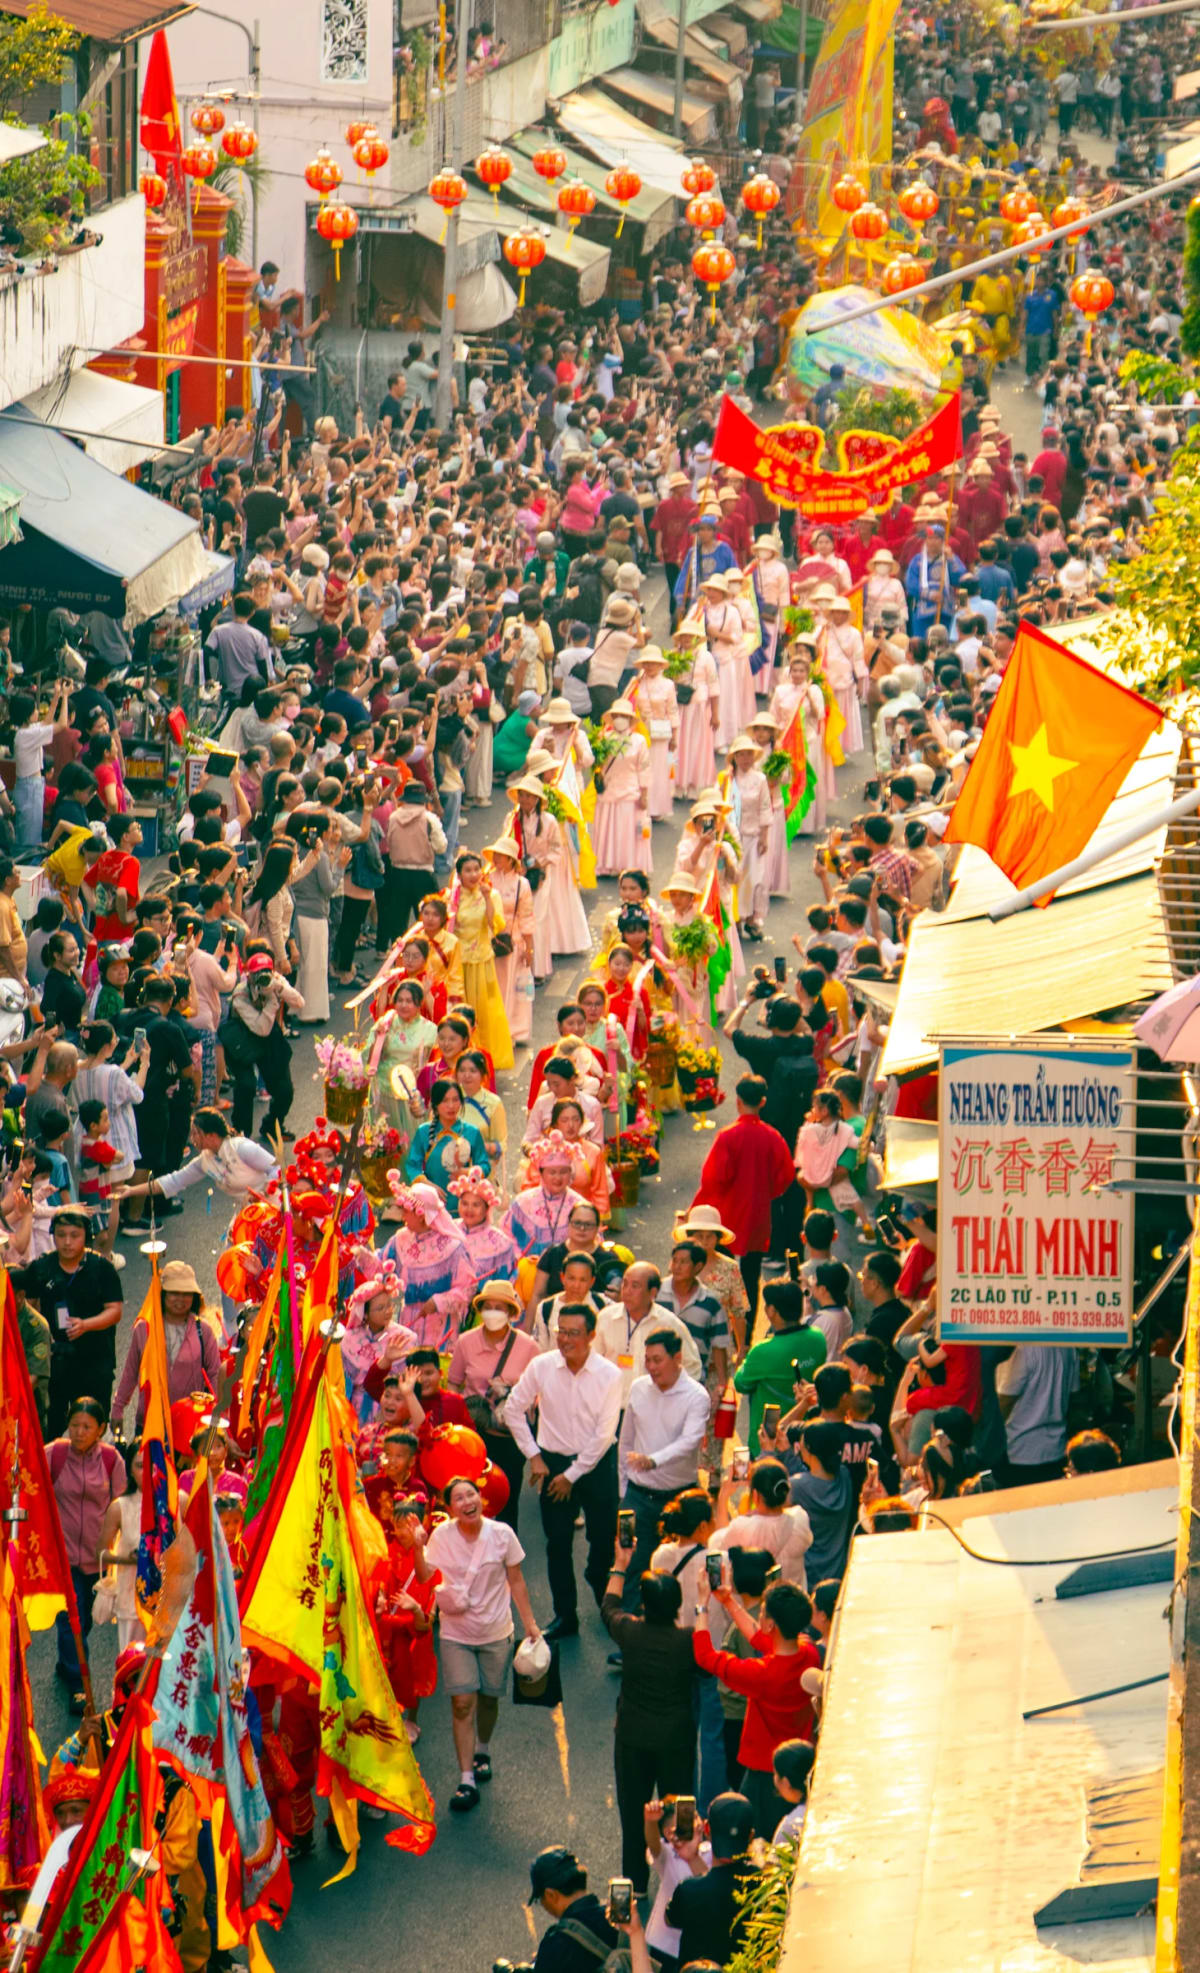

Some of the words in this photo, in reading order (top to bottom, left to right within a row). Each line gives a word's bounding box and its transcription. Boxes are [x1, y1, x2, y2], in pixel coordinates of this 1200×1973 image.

[949, 1082, 1010, 1124] NHANG
[1062, 1077, 1121, 1127] HƯƠNG
[952, 1202, 1027, 1278] THÁI
[1035, 1217, 1121, 1281] MINH
[951, 1288, 971, 1304] 2C
[1047, 1290, 1078, 1306] P.11
[1096, 1291, 1122, 1308] Q.5
[969, 1308, 1042, 1326] 0903.923.804
[1052, 1310, 1125, 1328] 0913.939.834
